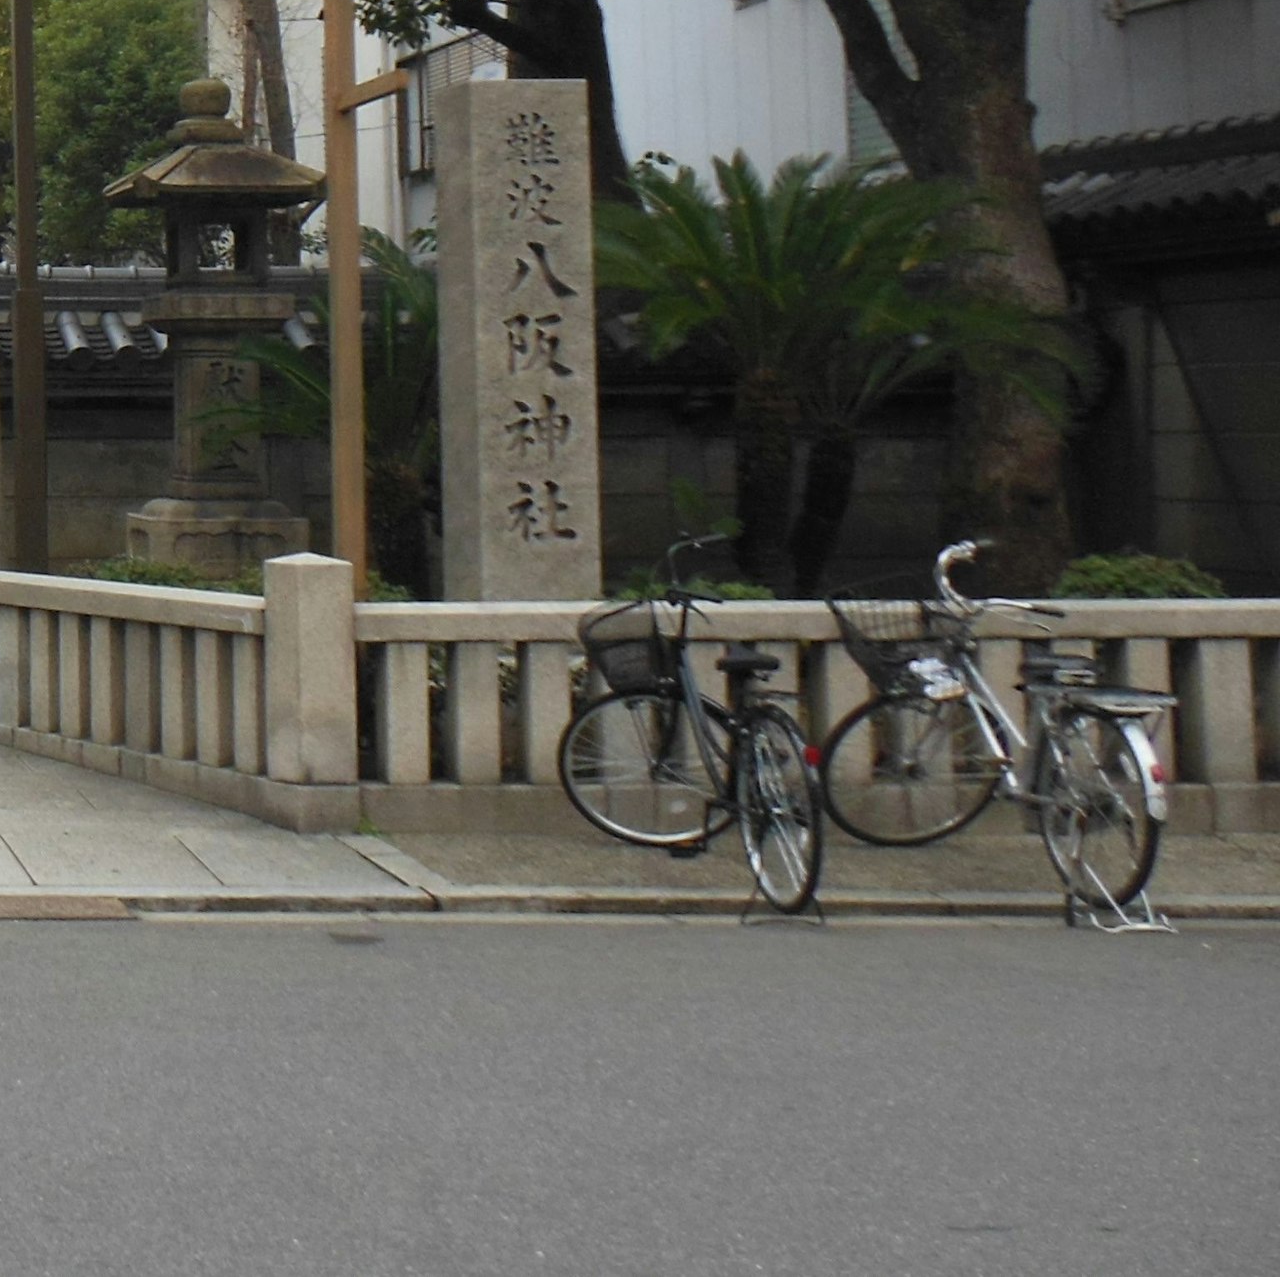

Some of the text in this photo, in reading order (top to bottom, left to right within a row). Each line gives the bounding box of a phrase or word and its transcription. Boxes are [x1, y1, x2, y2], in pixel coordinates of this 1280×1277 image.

[501, 111, 578, 542] 難波八阪神社
